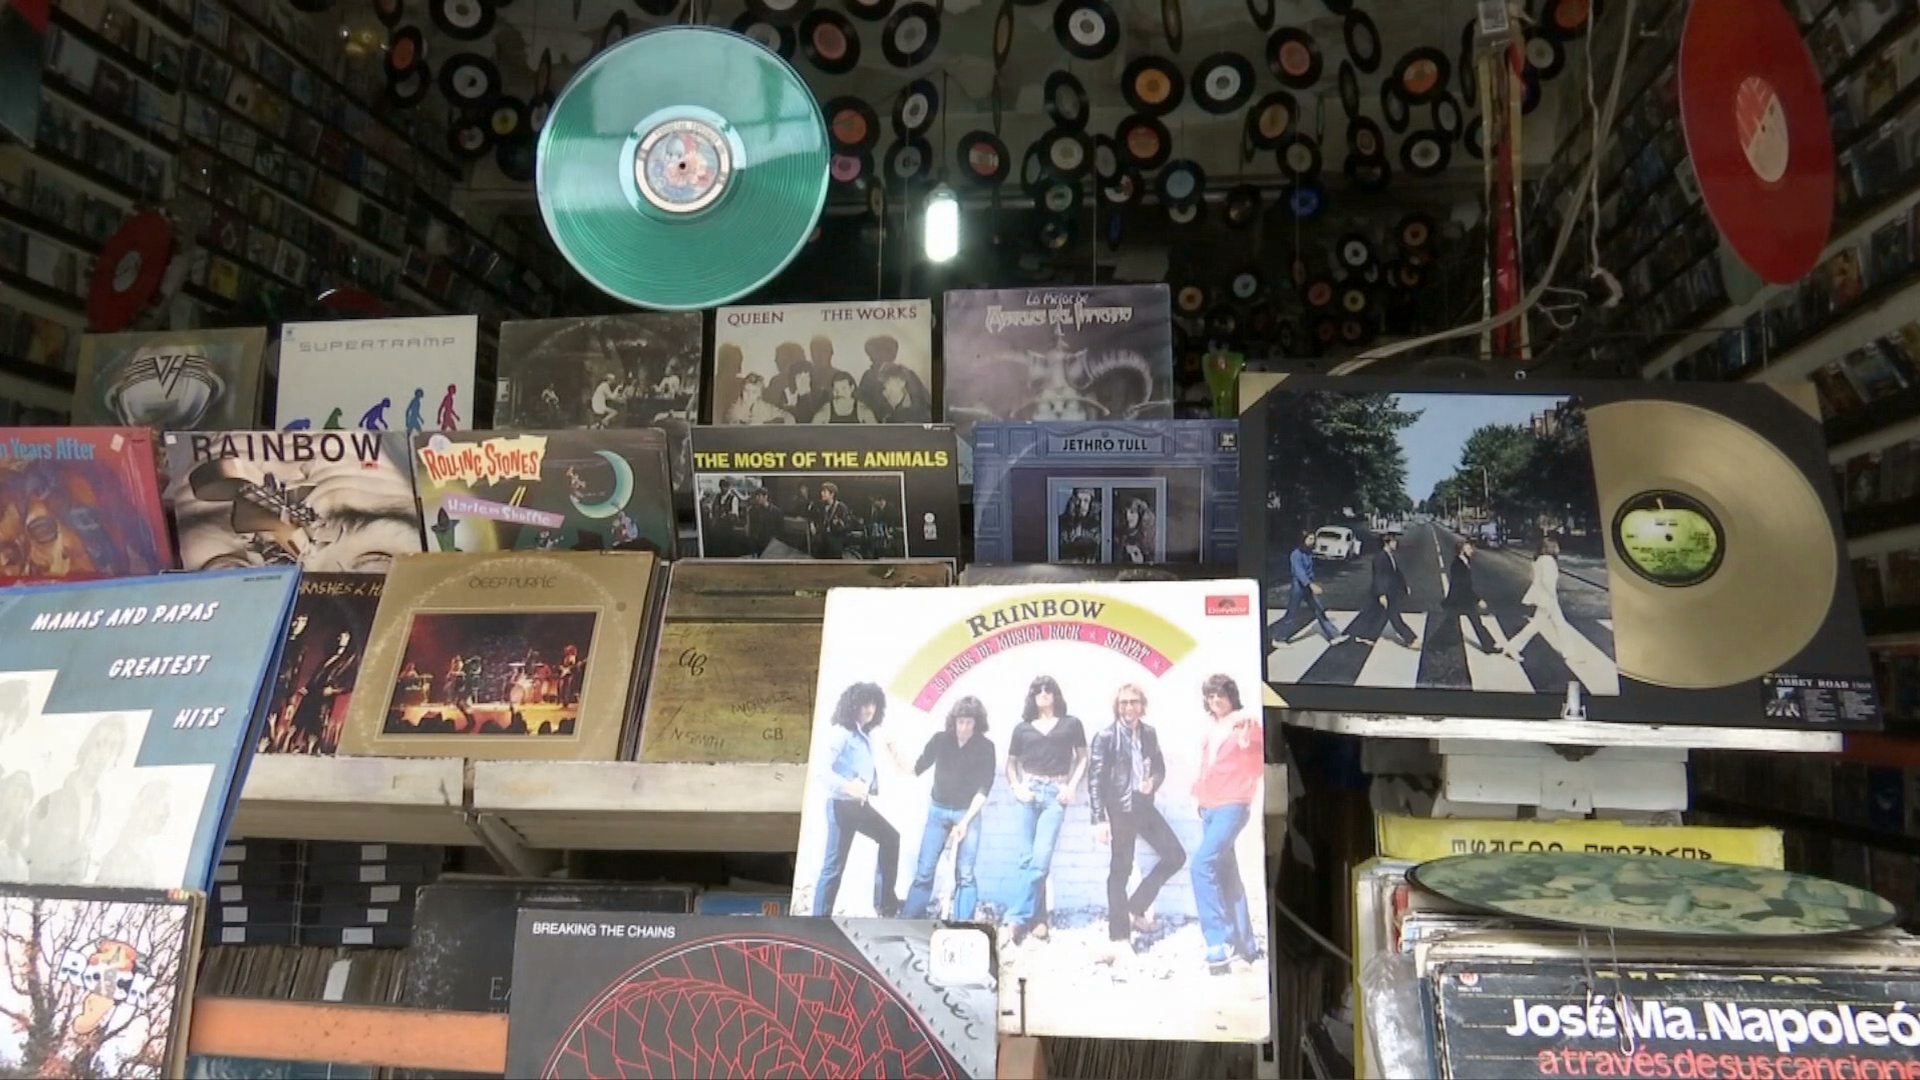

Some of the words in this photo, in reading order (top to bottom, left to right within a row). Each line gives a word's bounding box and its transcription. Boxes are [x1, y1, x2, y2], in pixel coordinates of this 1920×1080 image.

[727, 311, 784, 326] QUEEN
[821, 308, 851, 322] THE
[857, 306, 918, 321] WORKS
[299, 336, 456, 352] SUPERTRAMP
[10, 437, 52, 461] Years
[56, 437, 96, 461] After
[190, 433, 382, 462] RAINBOW
[1063, 438, 1114, 451] JETHRO
[1117, 438, 1148, 451] TULL
[423, 448, 483, 481] ROLLING
[485, 443, 538, 478] STONES
[694, 452, 730, 469] THE
[734, 452, 788, 469] MOST
[791, 452, 818, 468] OF
[822, 452, 858, 468] THE
[864, 450, 949, 468] ANIMALS
[447, 498, 500, 515] Harlem
[500, 505, 551, 525] Shuffle
[368, 581, 384, 597] H
[31, 609, 104, 632] MAMAS
[105, 607, 148, 628] AND
[151, 601, 220, 625] PAPAS
[966, 599, 1106, 638] RAINBOW
[1048, 624, 1081, 641] ROCK
[108, 655, 211, 679] GREATEST
[1776, 678, 1814, 688] ABBEY
[1818, 679, 1850, 689] ROAD
[172, 707, 226, 730] HITS
[532, 921, 596, 937] BREAKING
[600, 924, 625, 938] THE
[627, 925, 676, 939] CHAINS
[1506, 995, 1616, 1038] José
[1703, 1000, 1920, 1053] Napoleó
[1561, 1044, 1671, 1078] través
[1673, 1049, 1717, 1079] de
[1718, 1054, 1774, 1080] sus
